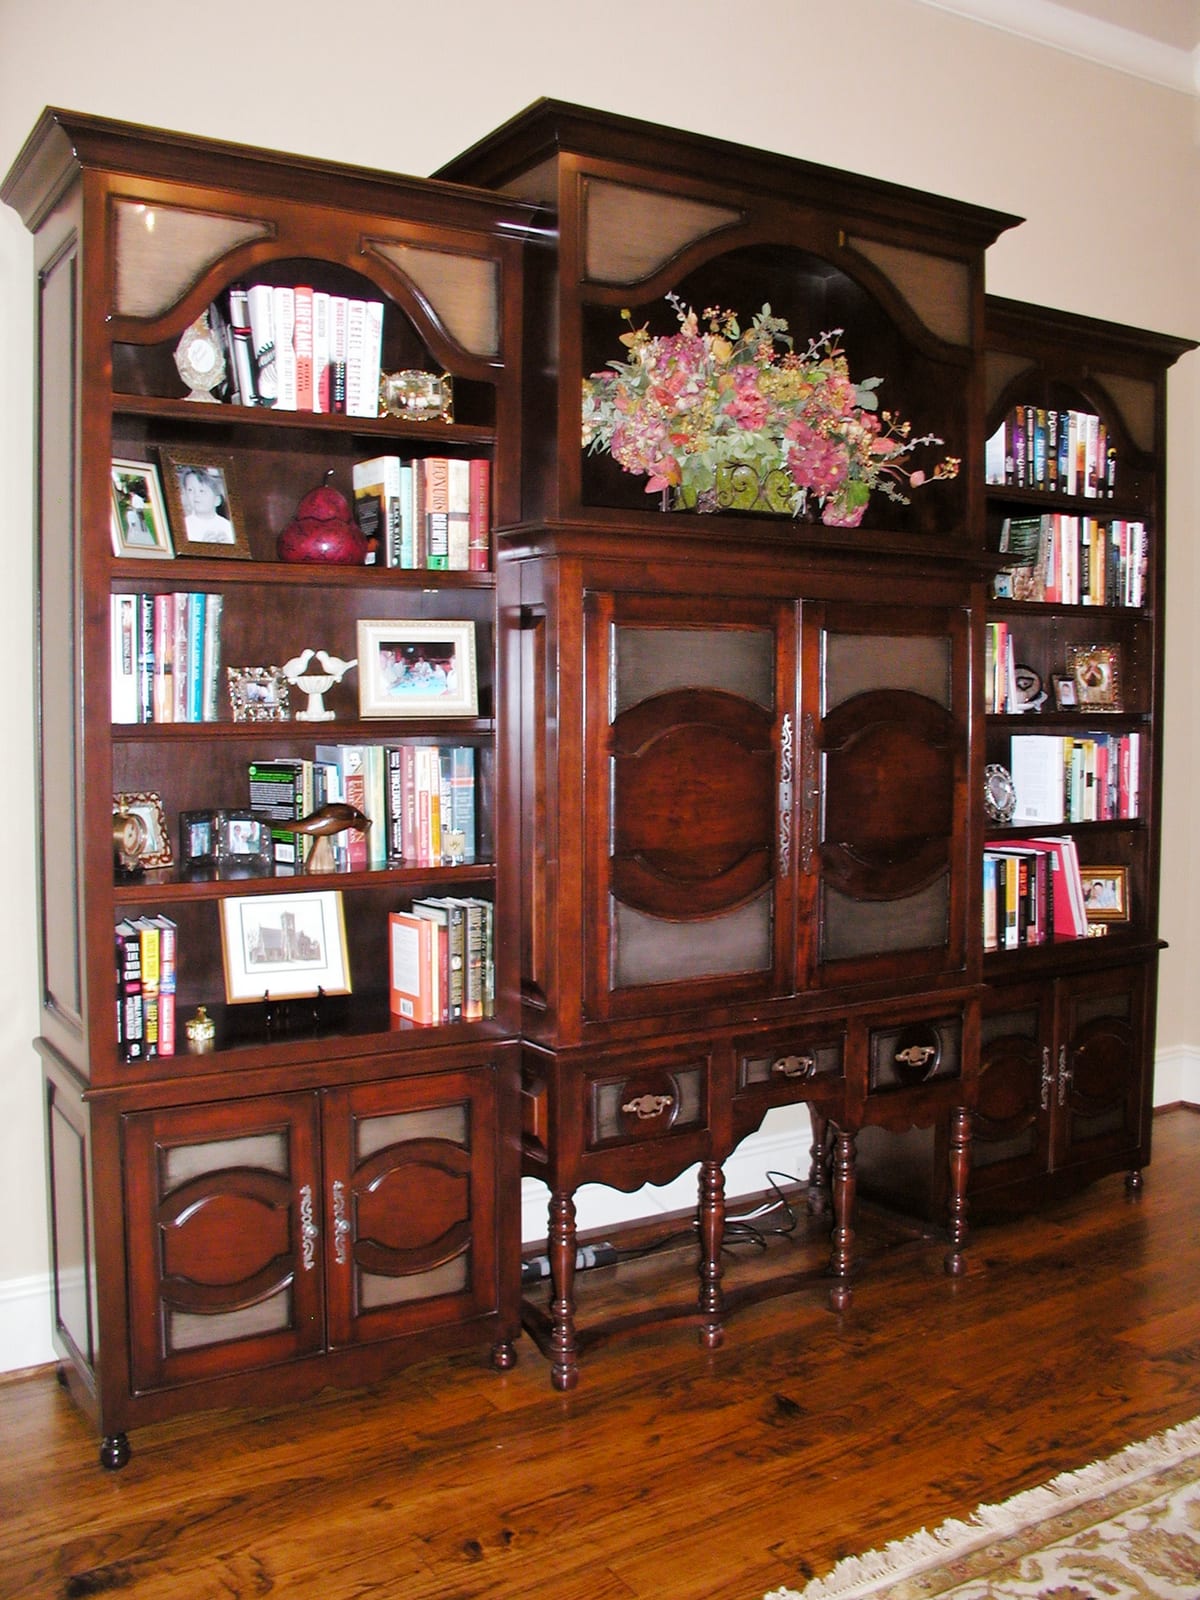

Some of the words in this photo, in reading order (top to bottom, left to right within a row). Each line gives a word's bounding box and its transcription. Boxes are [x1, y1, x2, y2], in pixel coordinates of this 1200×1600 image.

[296, 294, 312, 359] AIRFRAME
[349, 306, 363, 349] MICHAEL
[348, 358, 361, 407] CRICHTON
